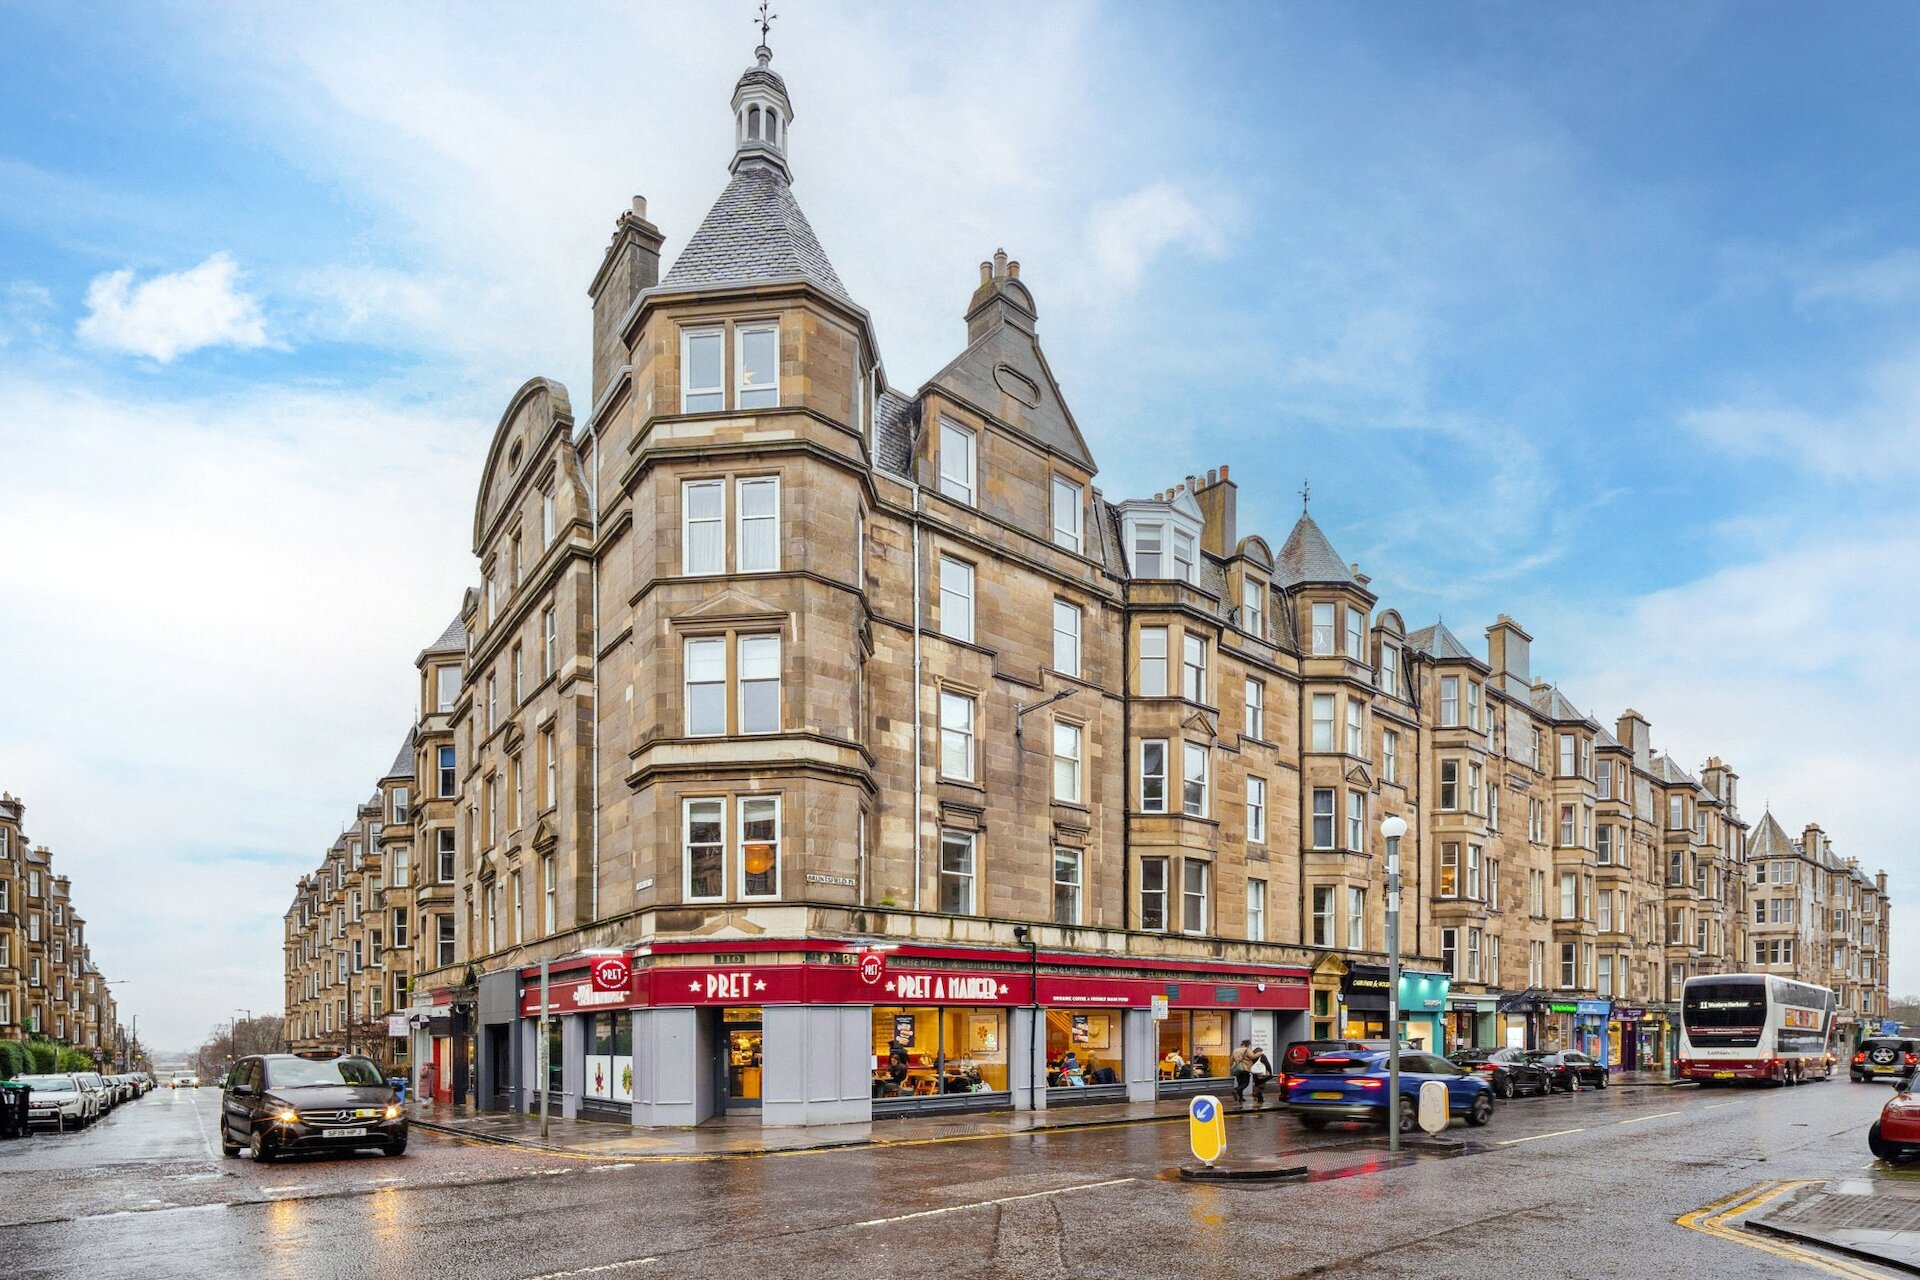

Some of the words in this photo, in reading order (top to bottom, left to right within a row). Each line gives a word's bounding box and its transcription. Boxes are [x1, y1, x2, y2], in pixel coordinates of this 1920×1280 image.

[719, 955, 741, 963] 110
[602, 968, 622, 980] PRET
[864, 964, 878, 976] PRET
[706, 972, 752, 998] PRET
[897, 975, 932, 999] PRET
[934, 977, 946, 999] A
[948, 977, 998, 999] MANGER
[1700, 1001, 1708, 1010] 11
